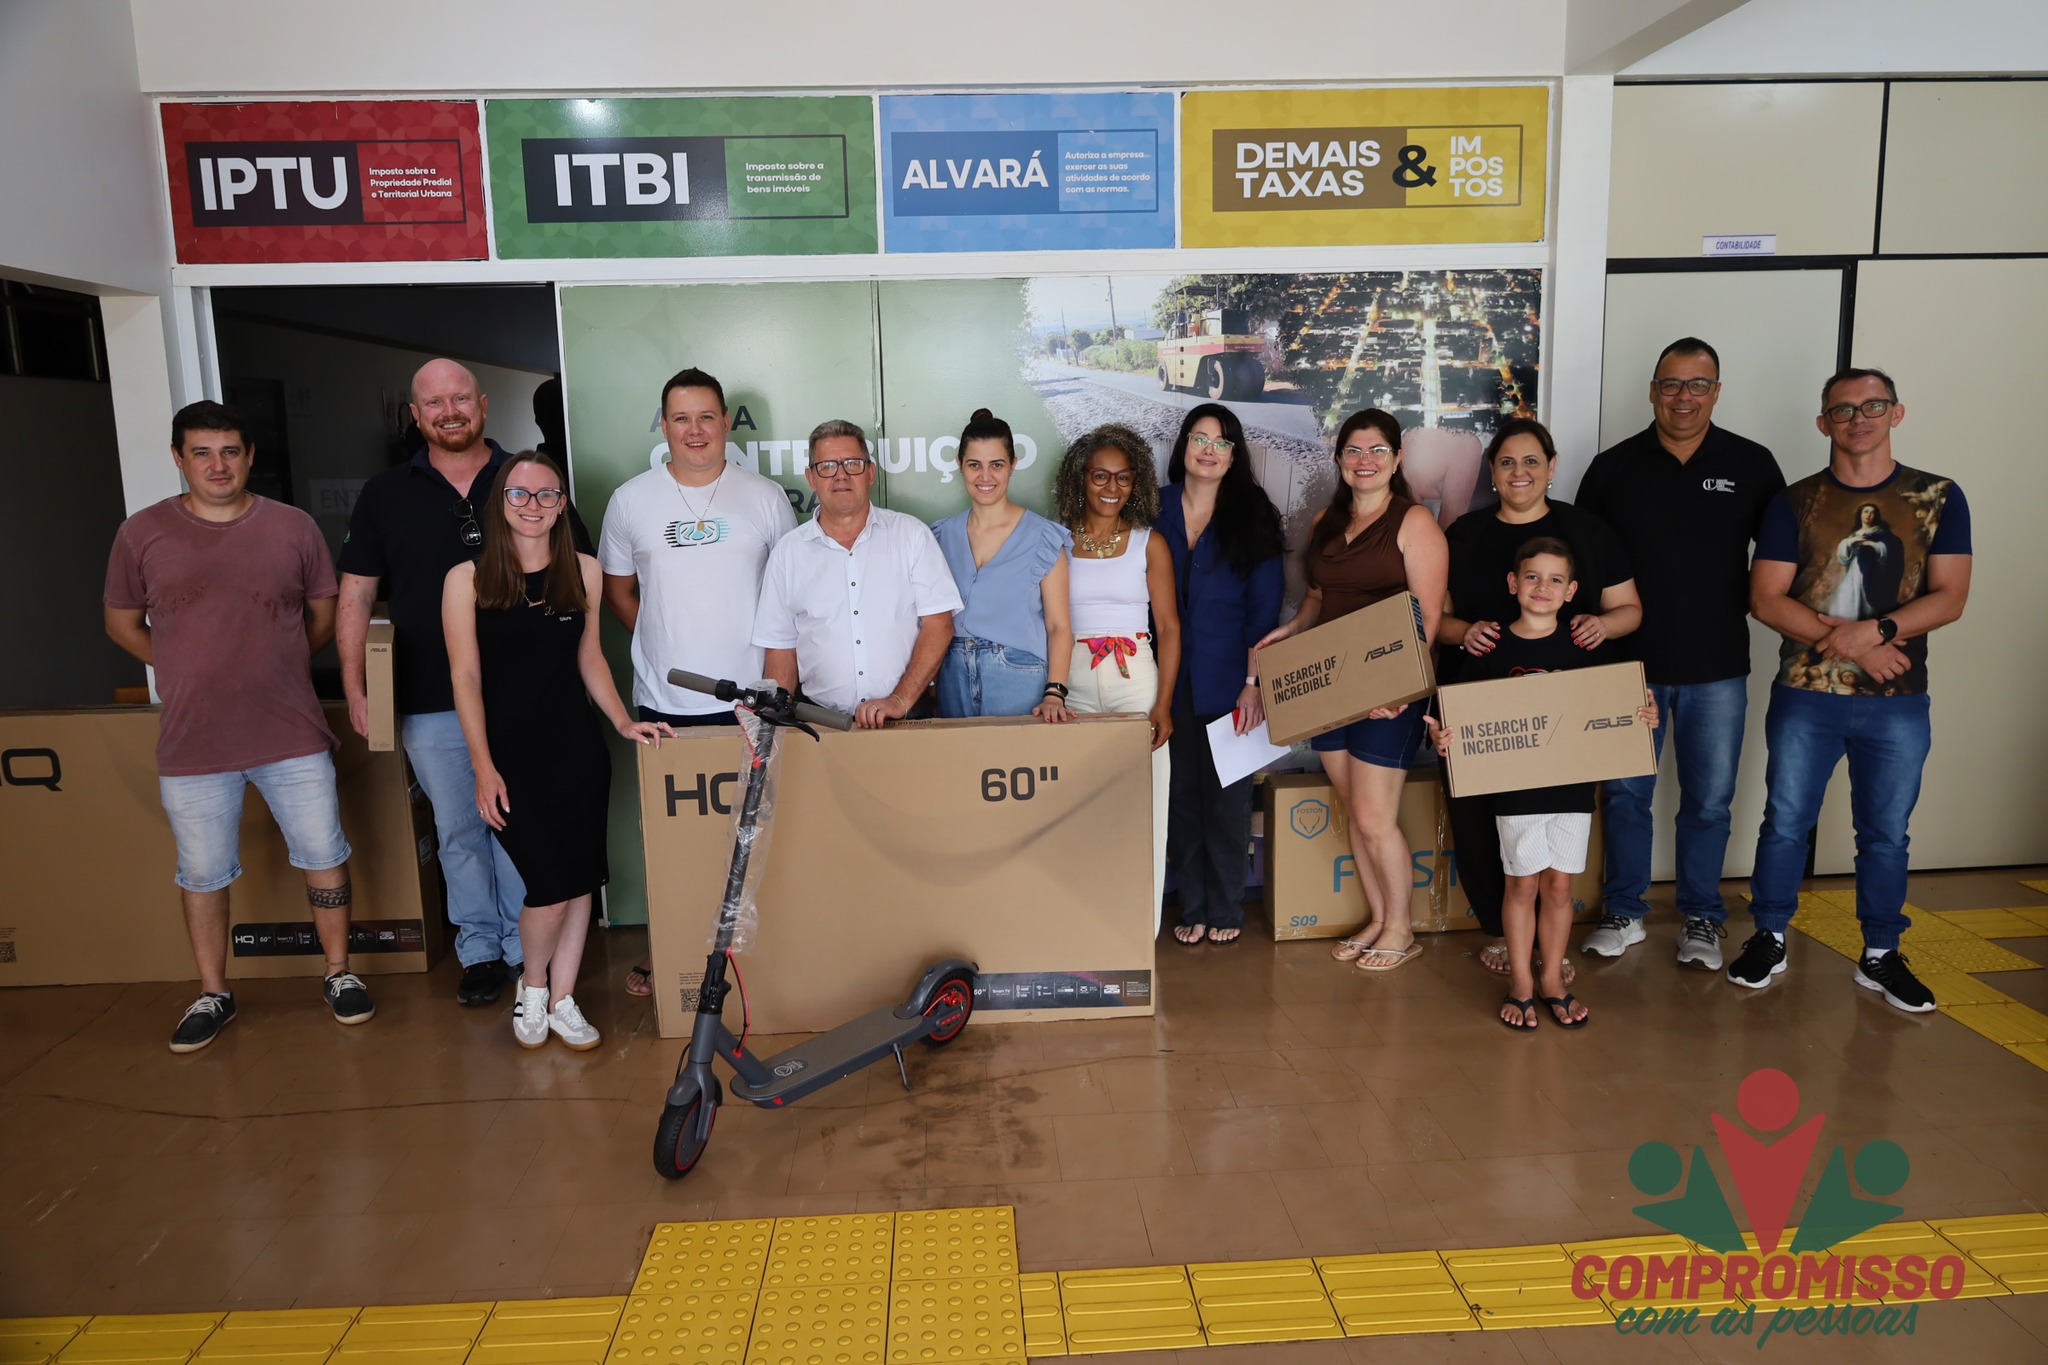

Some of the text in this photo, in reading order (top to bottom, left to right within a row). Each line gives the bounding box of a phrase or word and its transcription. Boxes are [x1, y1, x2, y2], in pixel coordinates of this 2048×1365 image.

[1450, 135, 1481, 154] IM
[1065, 151, 1100, 160] Autoriza
[1108, 152, 1145, 161] empresa
[1236, 140, 1381, 169] DEMAIS
[369, 167, 404, 177] Imposto
[405, 167, 429, 175] sobre
[746, 162, 786, 172] Imposto
[787, 162, 816, 170] sobre
[902, 150, 1049, 190] ALVARÁ
[1392, 144, 1437, 188] &
[1449, 156, 1504, 176] POS
[200, 157, 348, 211] IPTU
[370, 178, 452, 188] Propriedade Predial
[554, 152, 690, 206] ITBI
[746, 173, 821, 182] transmissão de
[1065, 172, 1151, 182] atividades de acordo
[1235, 170, 1365, 198] TAXAS
[378, 190, 419, 198] Territorial
[747, 184, 811, 193] bens imóveis
[1096, 185, 1130, 193] normas.
[1449, 177, 1503, 197] TOS
[1715, 240, 1762, 250] CONTABILIDADE
[1364, 640, 1403, 662] ASUS
[1272, 655, 1336, 691] IN SEARCH OF
[1274, 673, 1332, 705] INCREDIBLE
[1461, 715, 1548, 739] IN SEARCH OF
[1584, 715, 1633, 731] ASUS
[1463, 733, 1540, 755] INCREDIBLE
[981, 766, 1058, 802] 60"
[1290, 915, 1318, 927] S09
[235, 935, 254, 944] HQ
